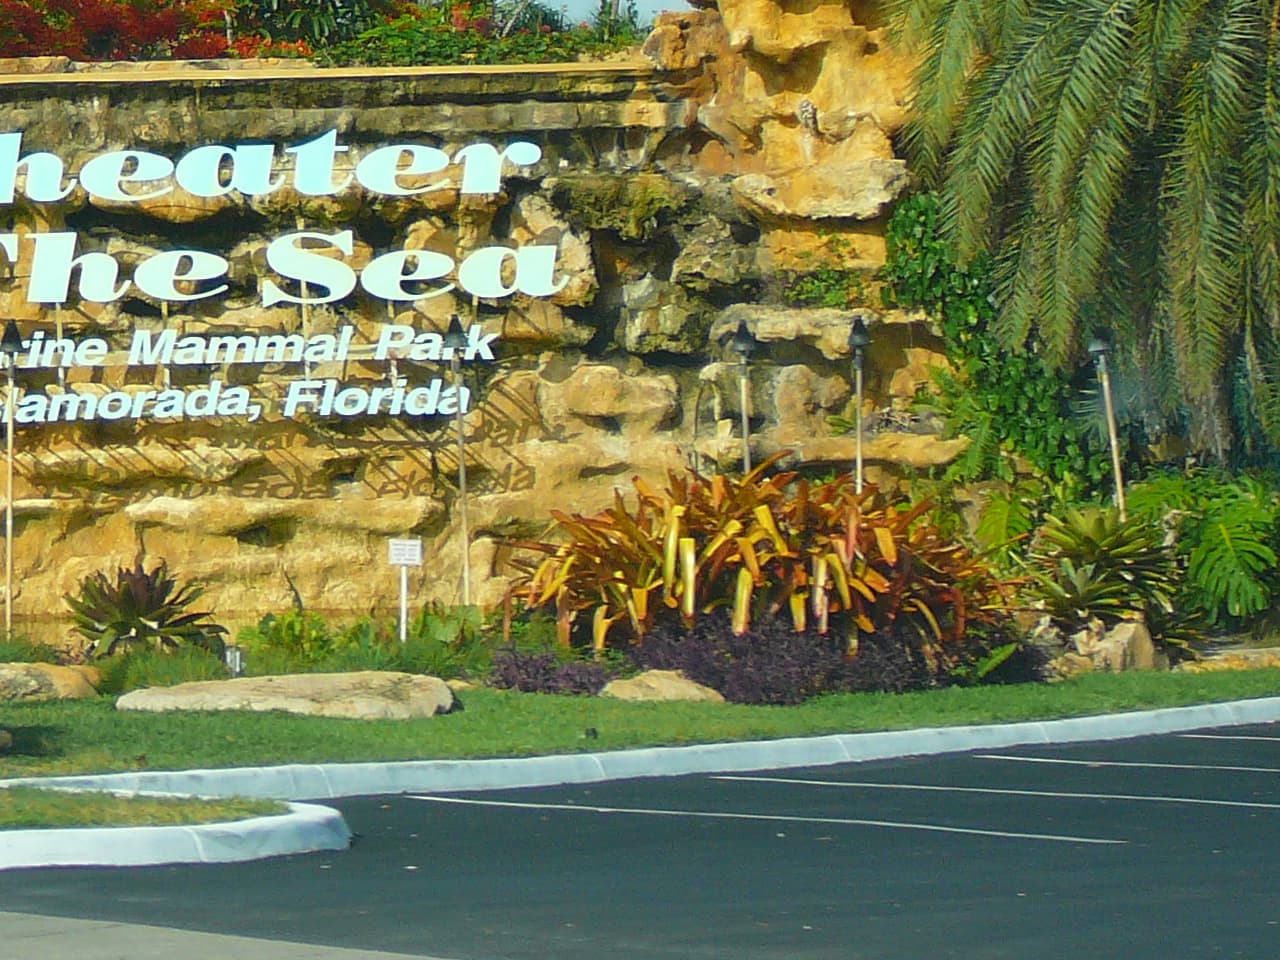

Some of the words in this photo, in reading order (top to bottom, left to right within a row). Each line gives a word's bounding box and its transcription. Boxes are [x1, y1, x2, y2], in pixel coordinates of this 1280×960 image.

[263, 230, 570, 308] Sea
[128, 325, 354, 365] Mammal
[283, 378, 471, 417] Florida
